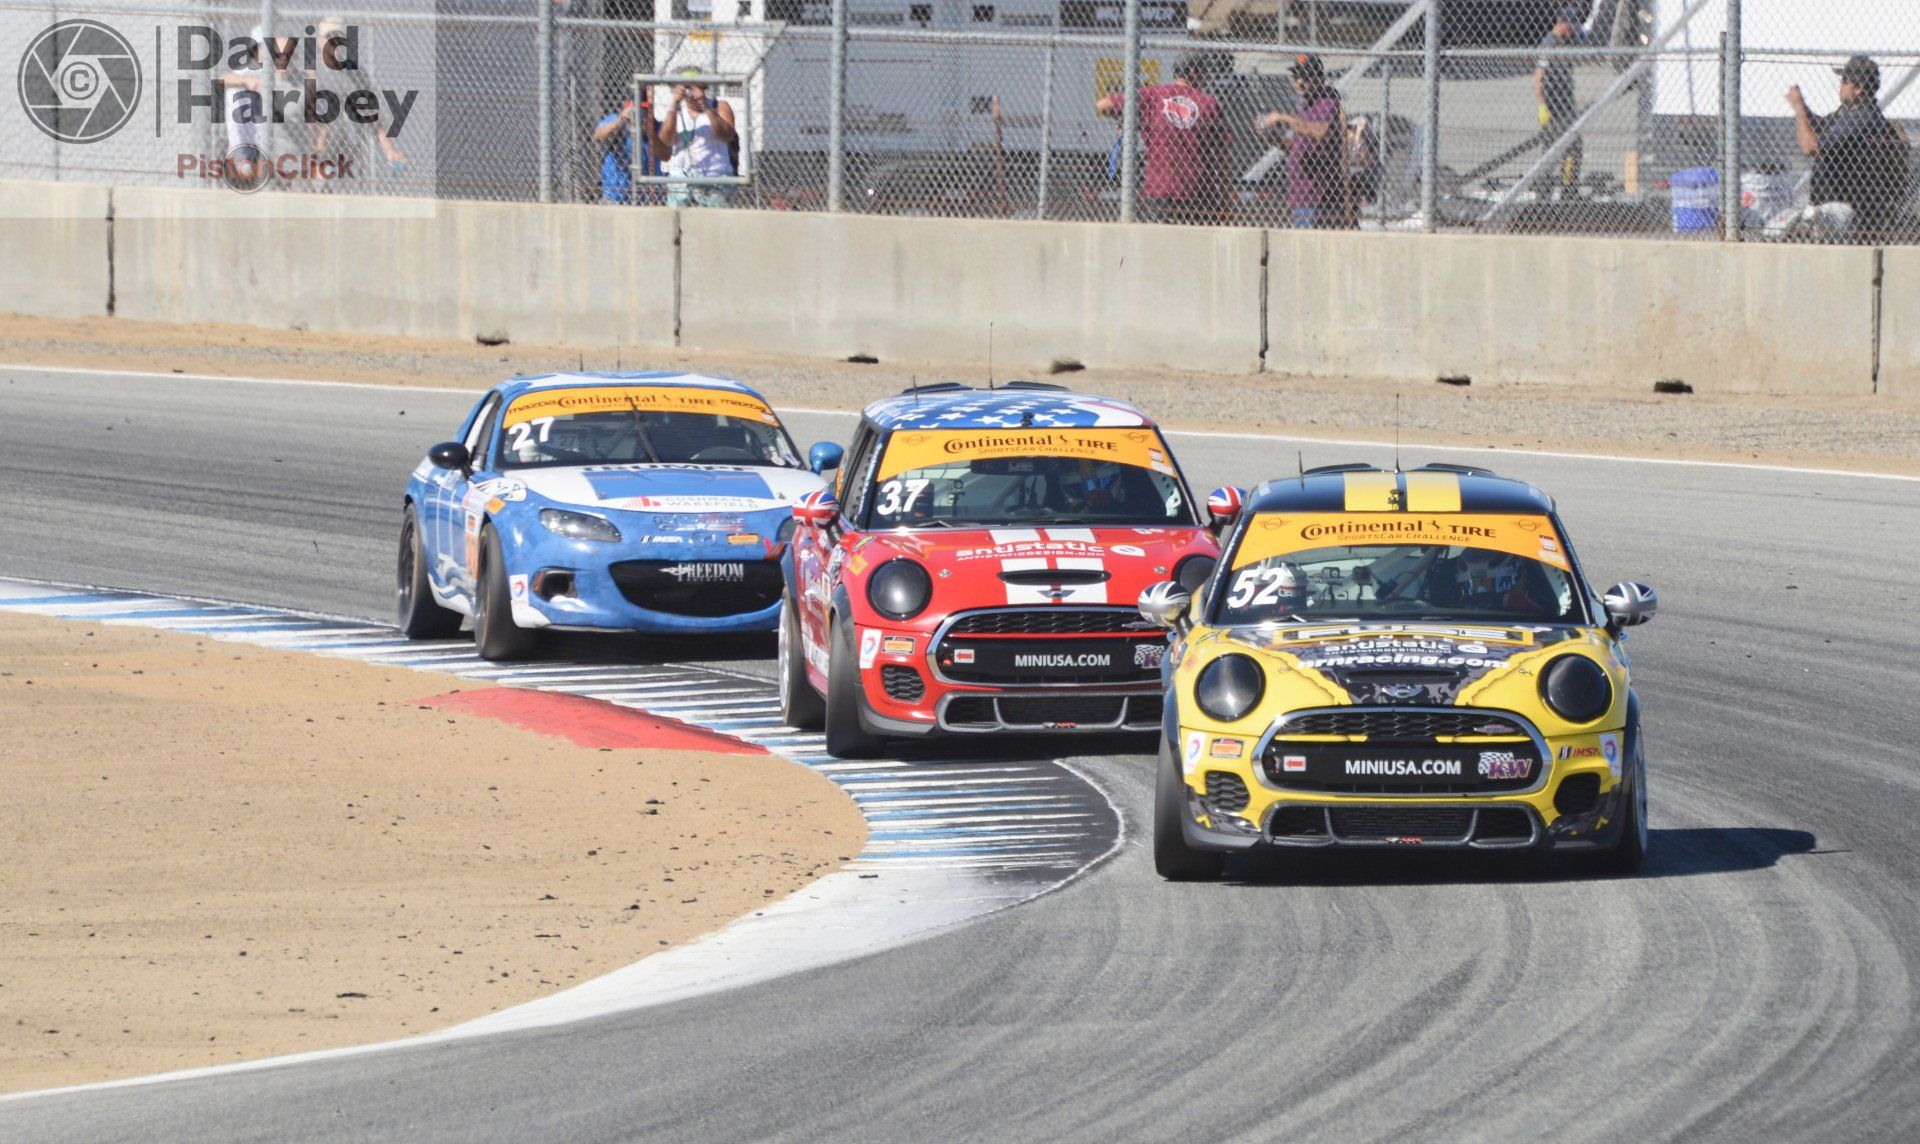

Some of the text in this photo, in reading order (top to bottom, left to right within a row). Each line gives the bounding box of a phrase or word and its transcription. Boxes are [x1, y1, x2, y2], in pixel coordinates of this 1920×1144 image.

[558, 393, 656, 408] Continental
[679, 397, 716, 407] TIRE
[508, 416, 555, 451] 27
[944, 434, 1052, 454] Continental
[1077, 438, 1118, 452] TIRE
[877, 478, 931, 516] 37
[1300, 519, 1423, 541] Continental
[1451, 523, 1497, 539] TIRE
[955, 541, 1105, 557] antistatic
[678, 562, 744, 580] FREEDOM
[1226, 568, 1292, 609] 52
[1324, 640, 1451, 653] antistatic
[1014, 653, 1111, 667] MINIUSA.COM
[1345, 759, 1462, 775] MINIUSA.COM
[1487, 758, 1533, 779] KW
